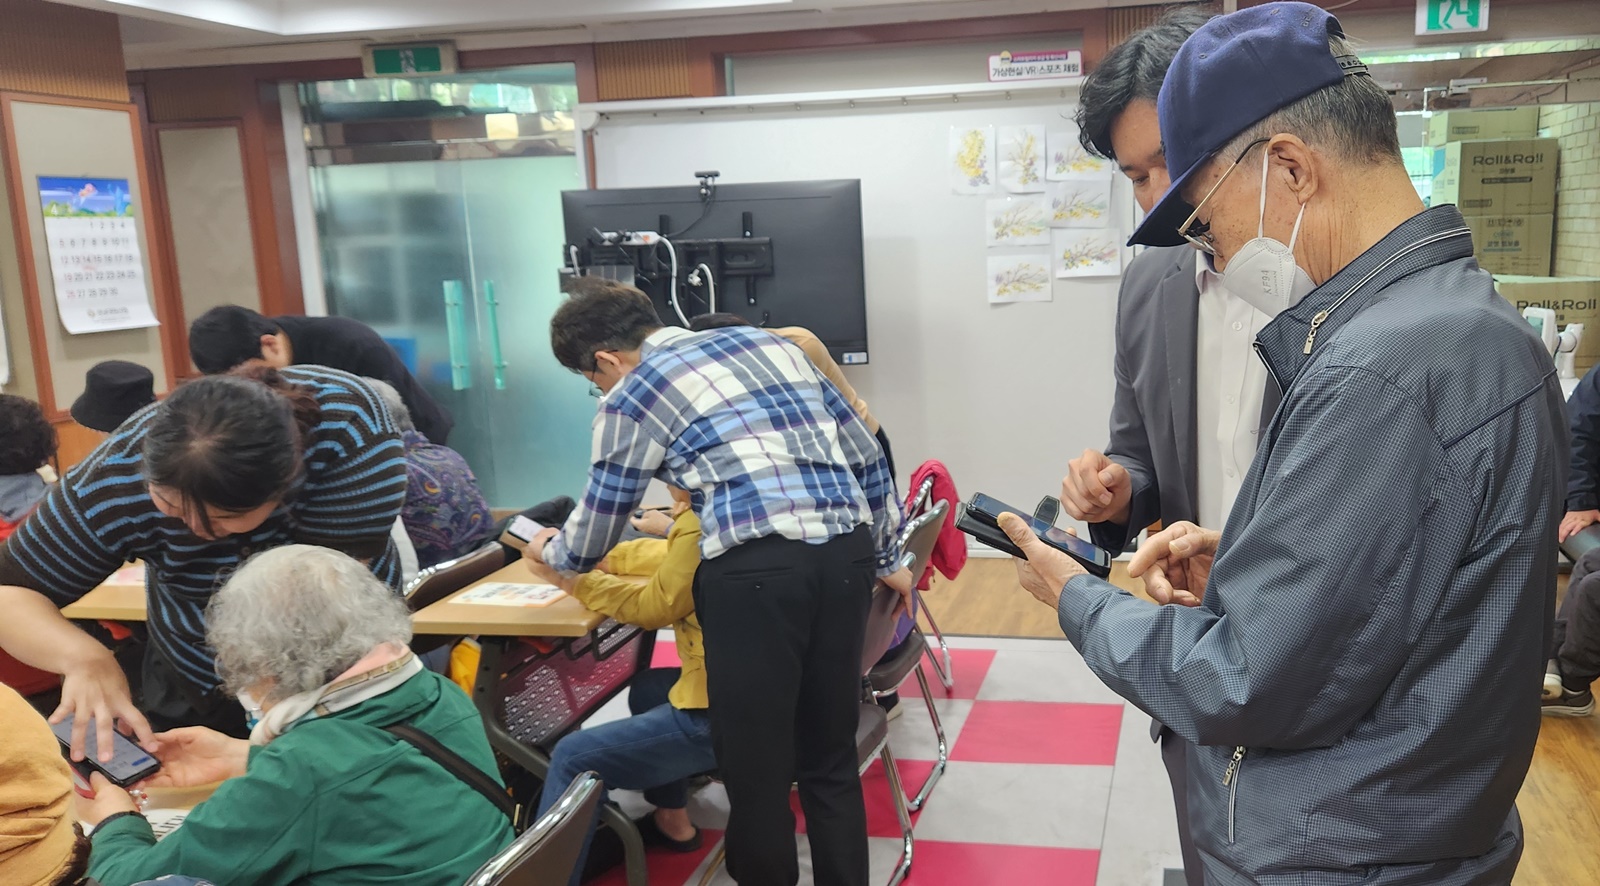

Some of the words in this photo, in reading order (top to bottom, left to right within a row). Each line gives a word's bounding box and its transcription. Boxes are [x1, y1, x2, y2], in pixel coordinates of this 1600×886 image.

[1039, 65, 1061, 74] 스포츠
[1473, 153, 1543, 165] Roll&Roll
[1261, 270, 1273, 295] KF94
